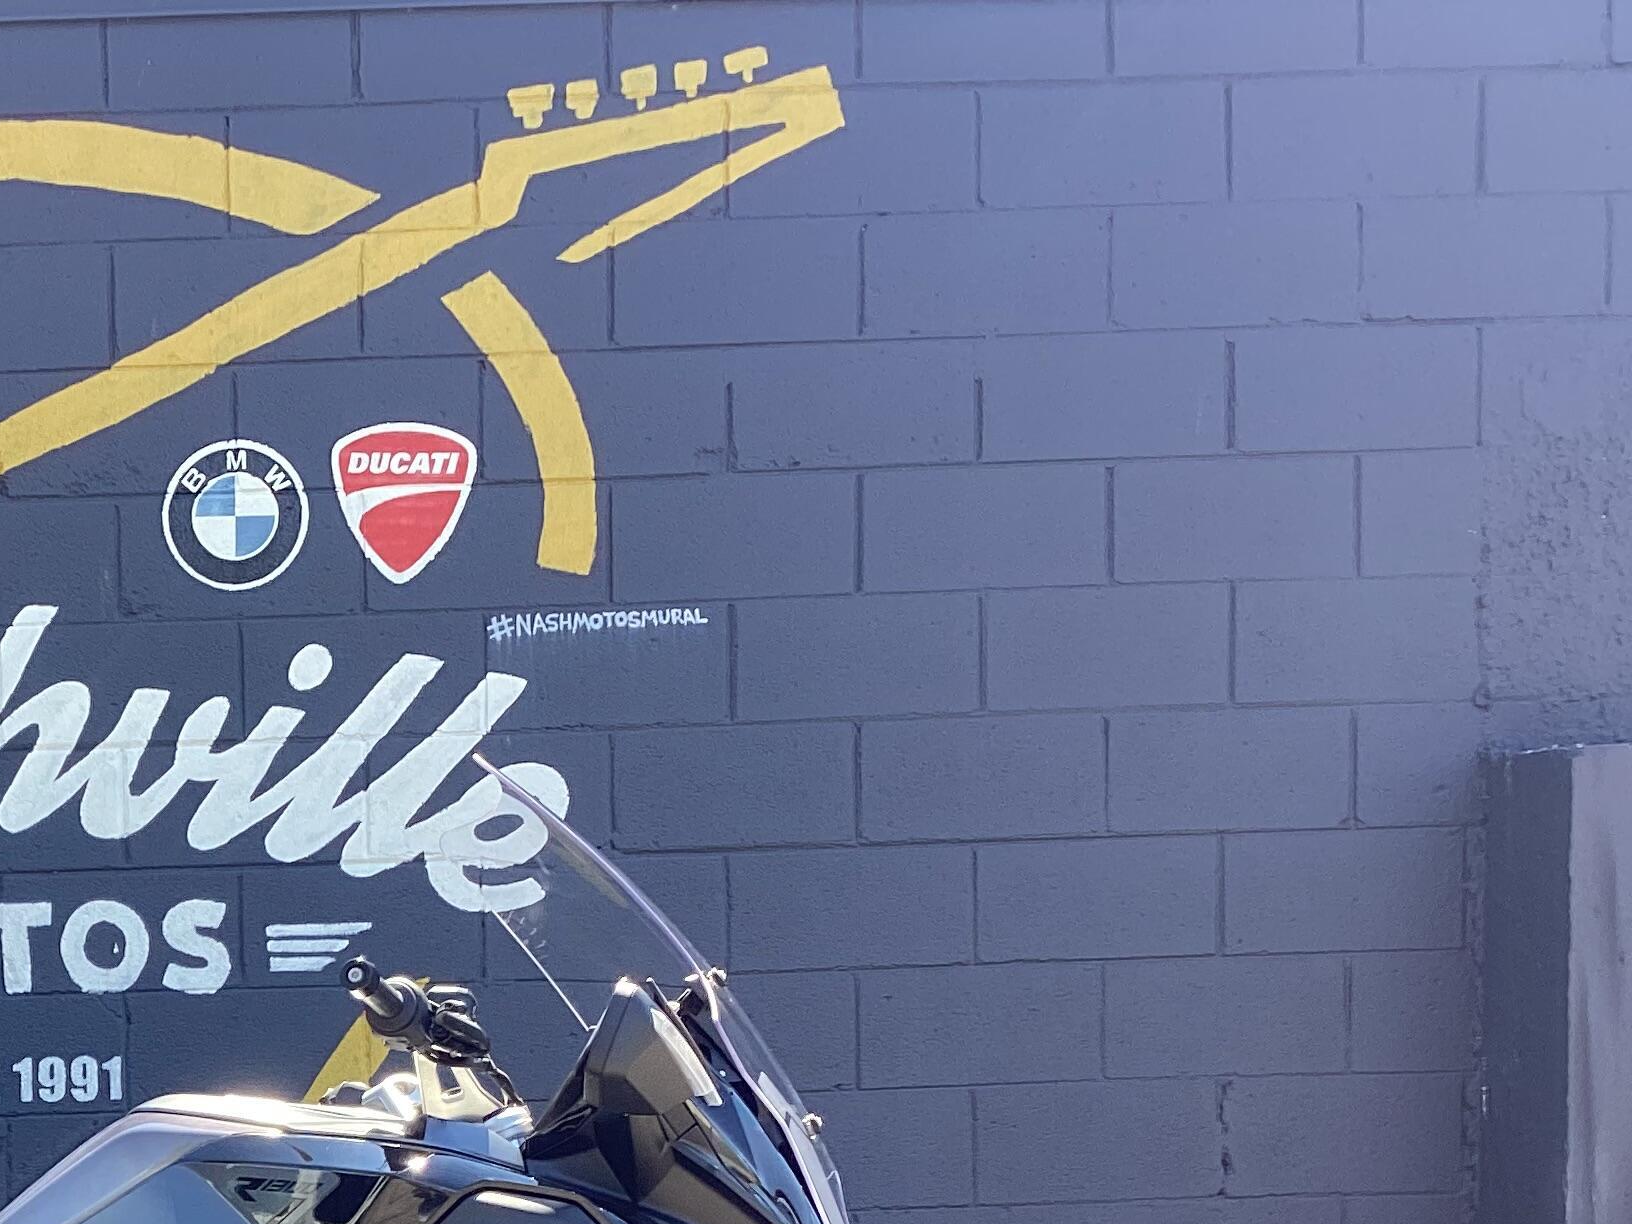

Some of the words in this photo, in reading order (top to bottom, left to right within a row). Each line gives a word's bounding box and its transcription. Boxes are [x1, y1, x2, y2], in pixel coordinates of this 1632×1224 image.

[179, 450, 293, 494] BMW
[347, 451, 460, 475] DUCATI
[486, 608, 709, 642] #NASHMOTOSMURAL
[12, 1055, 124, 1103] 1991
